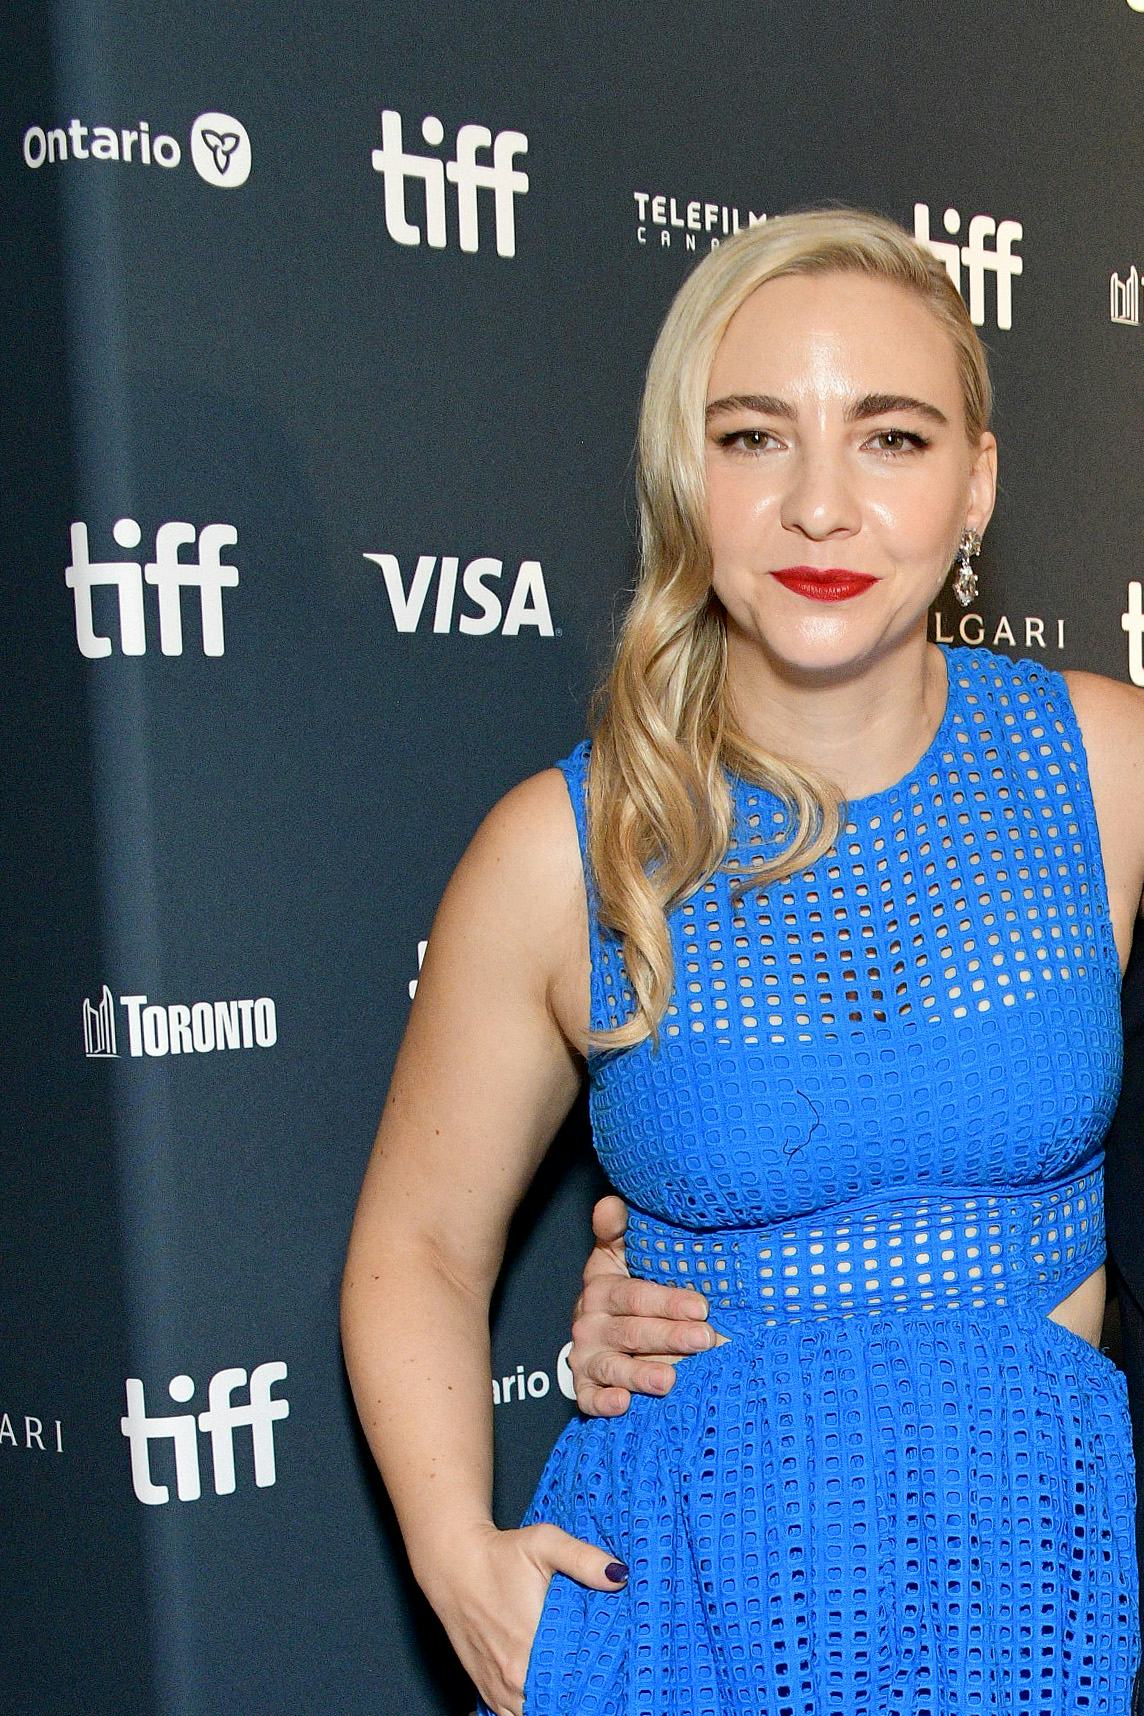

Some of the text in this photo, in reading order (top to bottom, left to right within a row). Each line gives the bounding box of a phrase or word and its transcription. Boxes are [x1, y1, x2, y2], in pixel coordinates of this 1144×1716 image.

[24, 120, 180, 168] Ontario
[372, 110, 528, 257] tiff
[637, 226, 720, 252] CANA
[66, 519, 239, 658] tiff
[363, 553, 554, 636] VISA
[935, 611, 1065, 649] LGARI
[120, 996, 276, 1056] TORONTO
[121, 1362, 289, 1504] tiff
